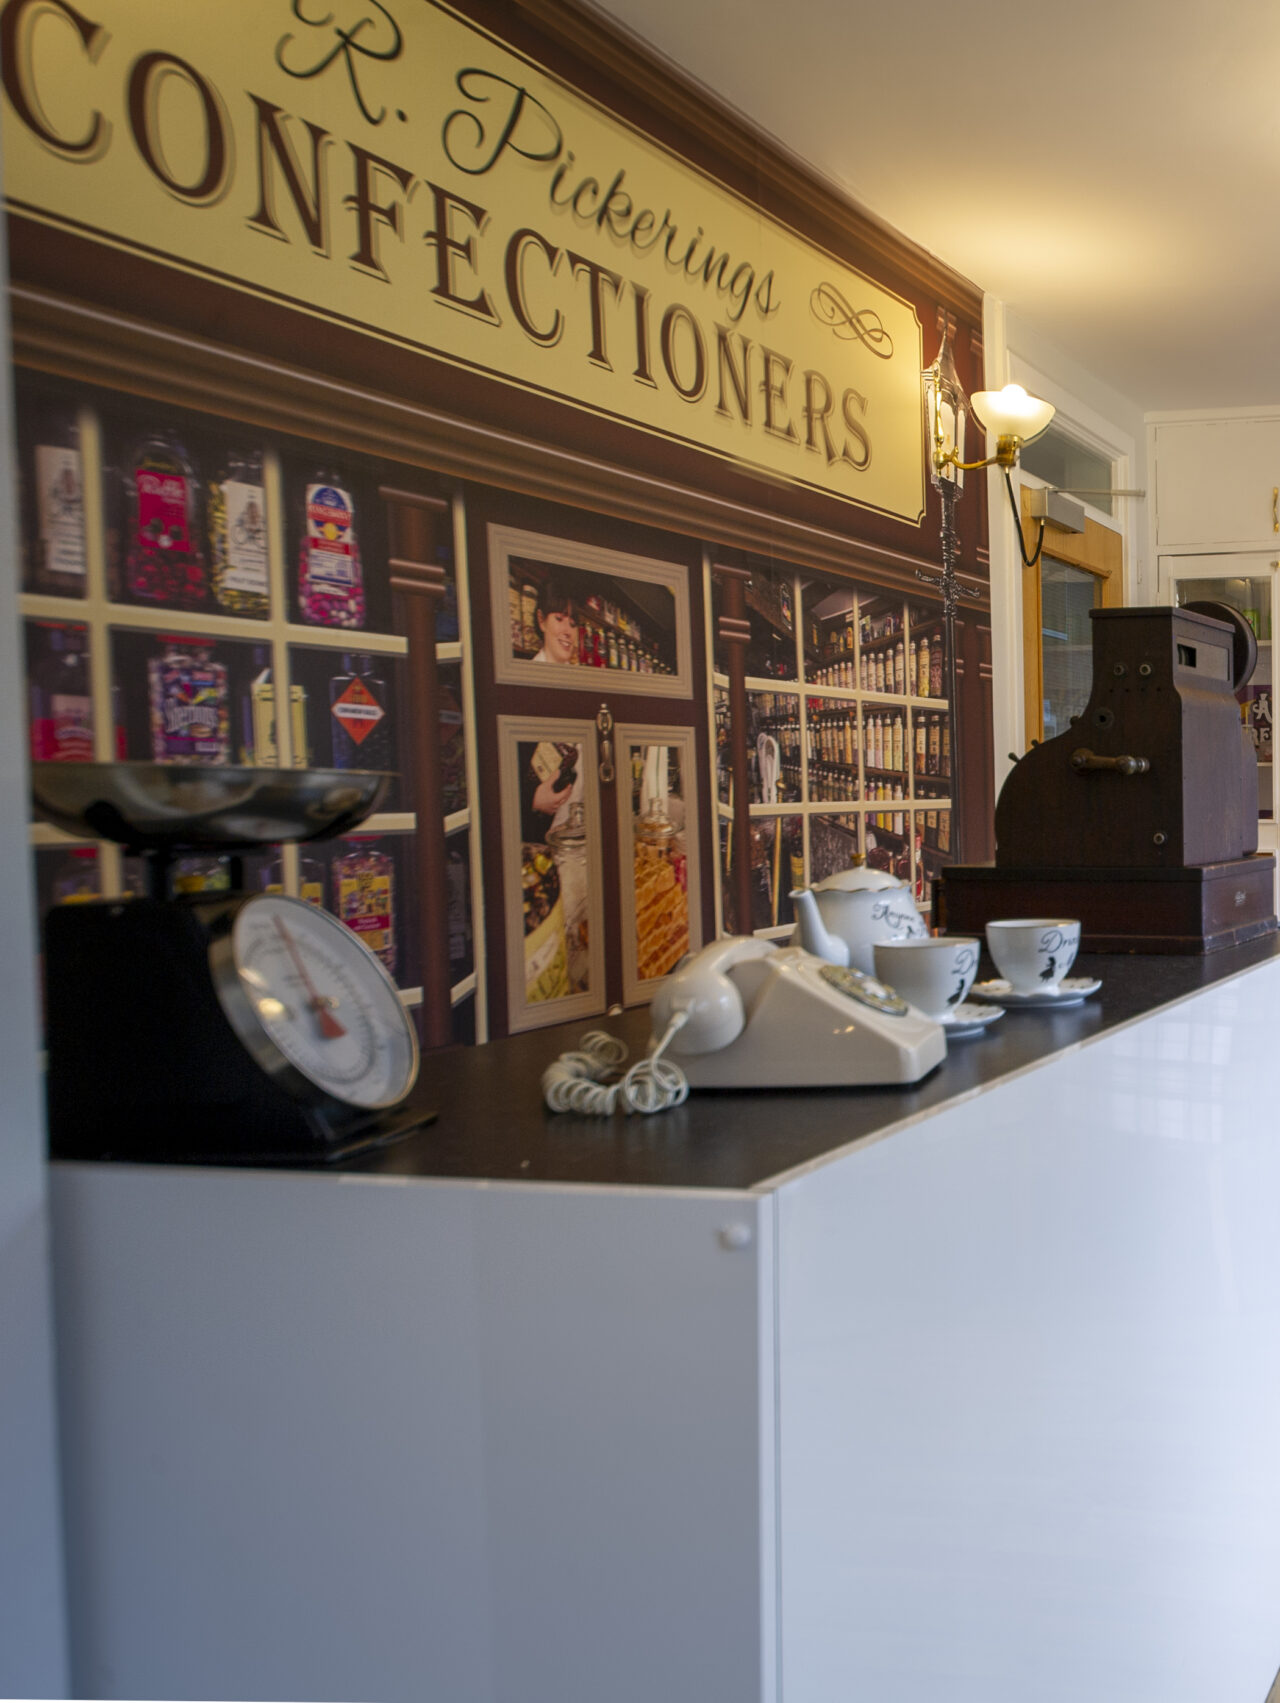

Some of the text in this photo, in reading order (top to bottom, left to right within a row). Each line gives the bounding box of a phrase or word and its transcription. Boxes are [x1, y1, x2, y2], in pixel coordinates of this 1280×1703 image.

[0, 0, 872, 472] CONFECTIONERS
[275, 0, 781, 321] R. Pickerings
